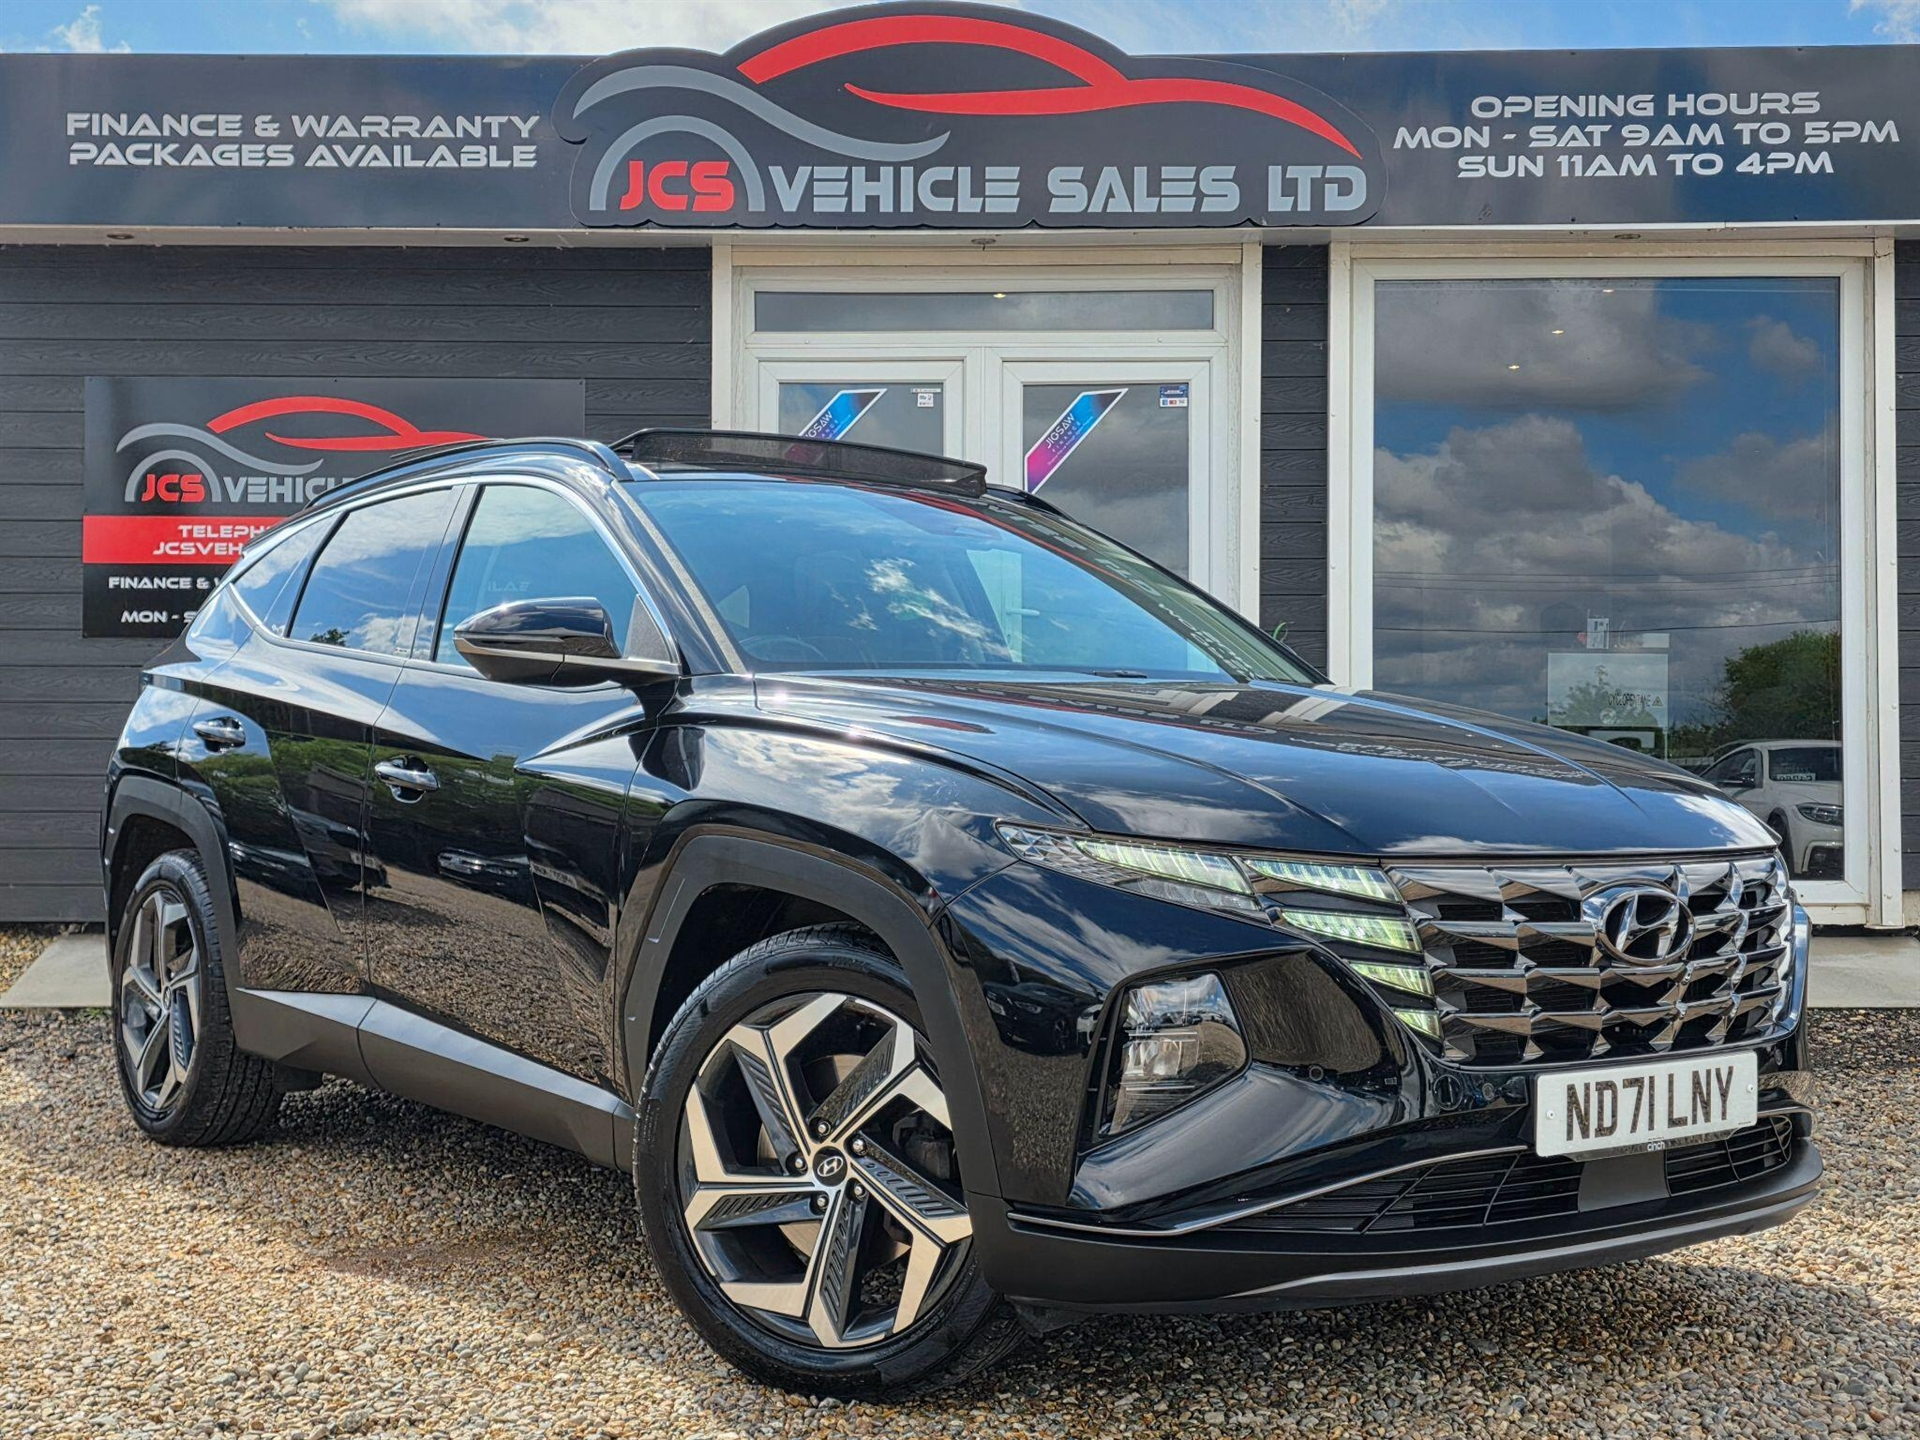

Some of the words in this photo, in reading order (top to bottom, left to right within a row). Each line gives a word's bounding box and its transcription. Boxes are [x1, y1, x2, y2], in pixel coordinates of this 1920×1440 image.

[1471, 95, 1655, 119] OPENING
[1668, 92, 1822, 117] HOURS
[67, 113, 243, 137] FINANCE
[254, 115, 281, 138] &
[292, 115, 541, 138] WARRANTY
[1394, 126, 1491, 150] MON
[1529, 125, 1613, 148] SAT
[1621, 124, 1725, 147] 9AM
[1734, 122, 1792, 145] TO
[1804, 120, 1901, 144] 5PM
[69, 143, 296, 167] PACKAGES
[304, 145, 538, 168] AVAILABLE
[1458, 156, 1545, 179] SUN
[1556, 155, 1659, 178] 11AM
[1666, 154, 1725, 177] TO
[1736, 152, 1835, 176] 4PM
[620, 161, 735, 212] JCS
[769, 166, 1021, 213] VEHICLE
[1047, 166, 1241, 213] SALES
[1268, 166, 1368, 213] LTD
[1045, 412, 1075, 449] JIGSAW
[142, 474, 206, 503] JCS
[223, 477, 357, 503] VEHIC
[178, 524, 272, 539] TELEPH
[153, 543, 243, 556] JCSVEH
[108, 577, 192, 590] FINANCE
[196, 577, 210, 590] &
[121, 611, 168, 623] MON
[1667, 1066, 1734, 1128] LNY
